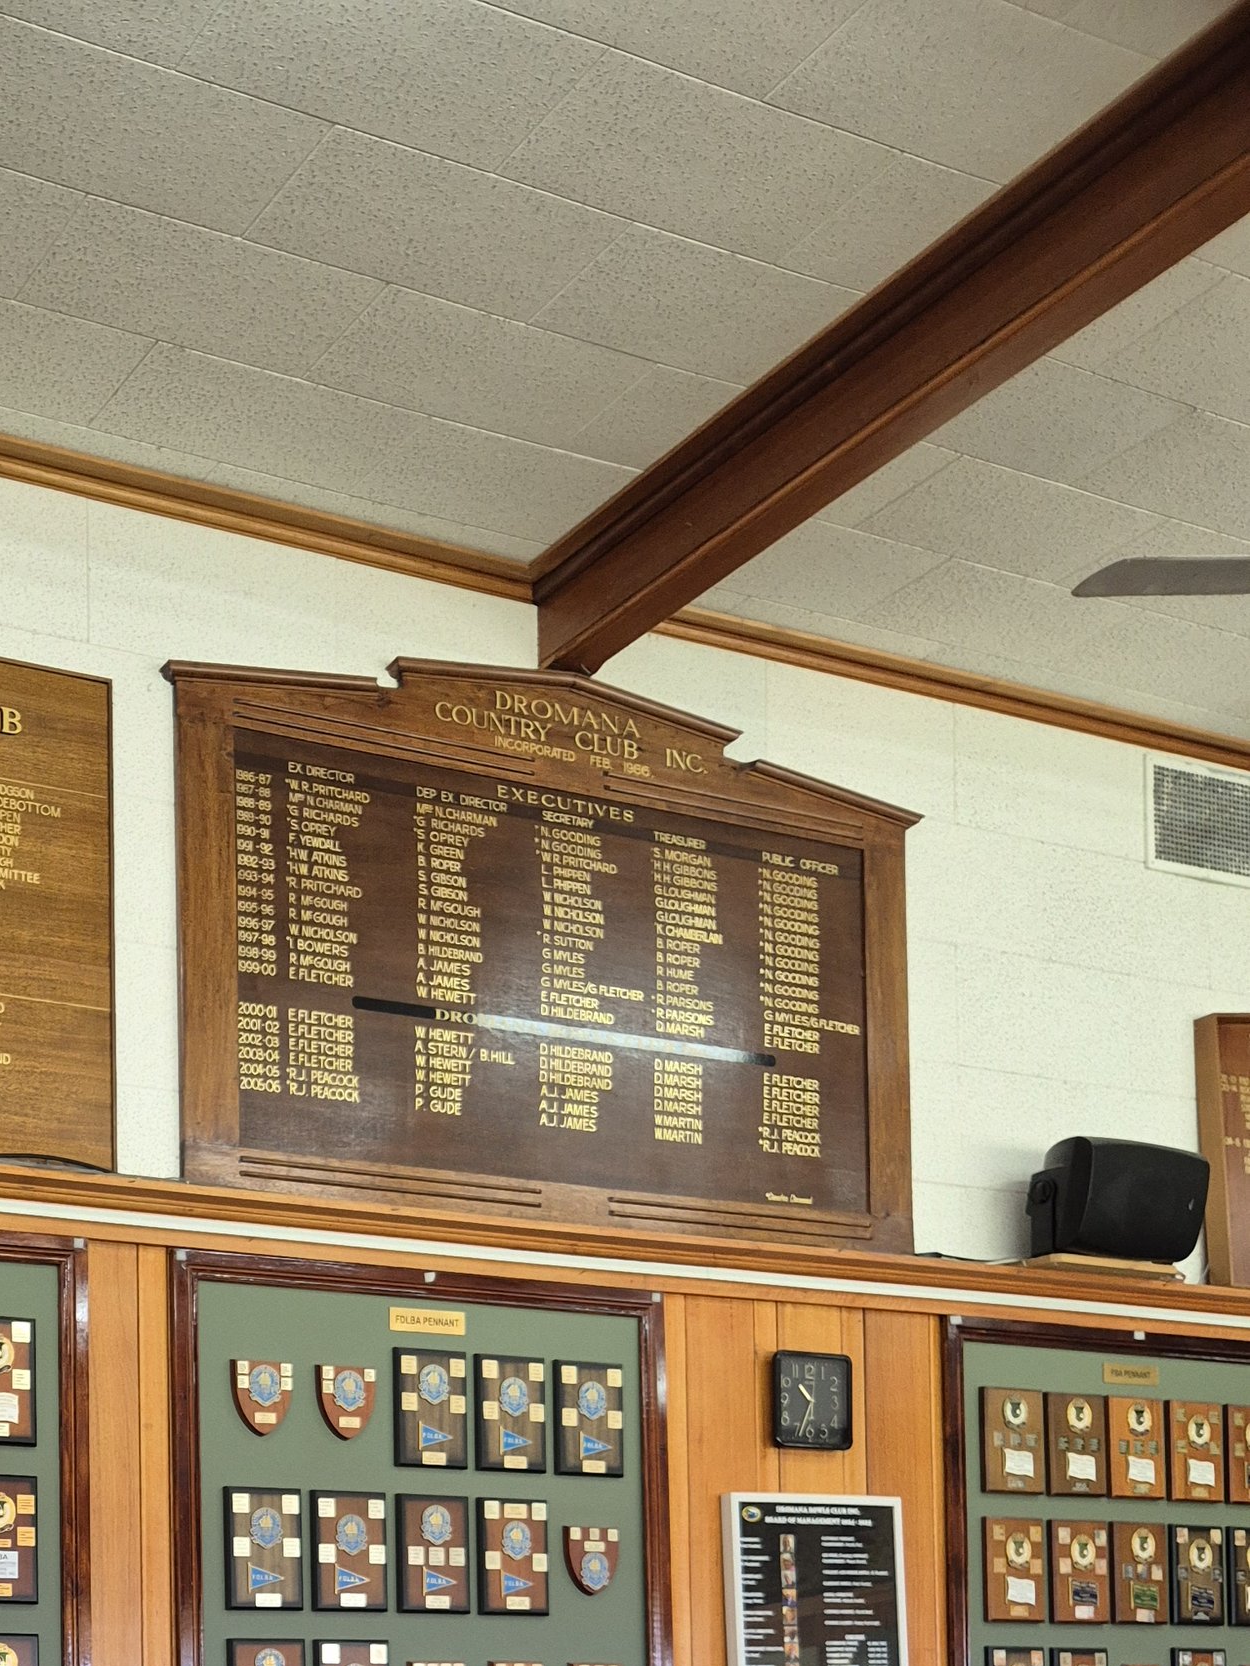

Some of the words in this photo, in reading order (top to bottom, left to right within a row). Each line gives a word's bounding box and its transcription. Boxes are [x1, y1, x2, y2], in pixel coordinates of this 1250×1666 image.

[495, 690, 641, 738] DROMANA
[435, 701, 551, 742] COUNTRY
[575, 731, 639, 760] CLUB
[494, 736, 576, 763] INCORPORATED
[303, 808, 359, 827] RICHARDS
[306, 765, 355, 784] DIRECTOR
[459, 794, 507, 813] DIRECTOR
[542, 810, 595, 829] SECRETARY
[653, 831, 706, 849] TREASURER
[497, 785, 634, 823] EXECUTIVES
[431, 819, 485, 837] RICHARDS
[297, 939, 348, 958] BOWERS
[430, 959, 471, 976] JAMES
[429, 1085, 463, 1101] GUDE
[429, 1100, 462, 1116] GUDE
[395, 1315, 421, 1326] FDLBA
[423, 1316, 459, 1328] PENNANT
